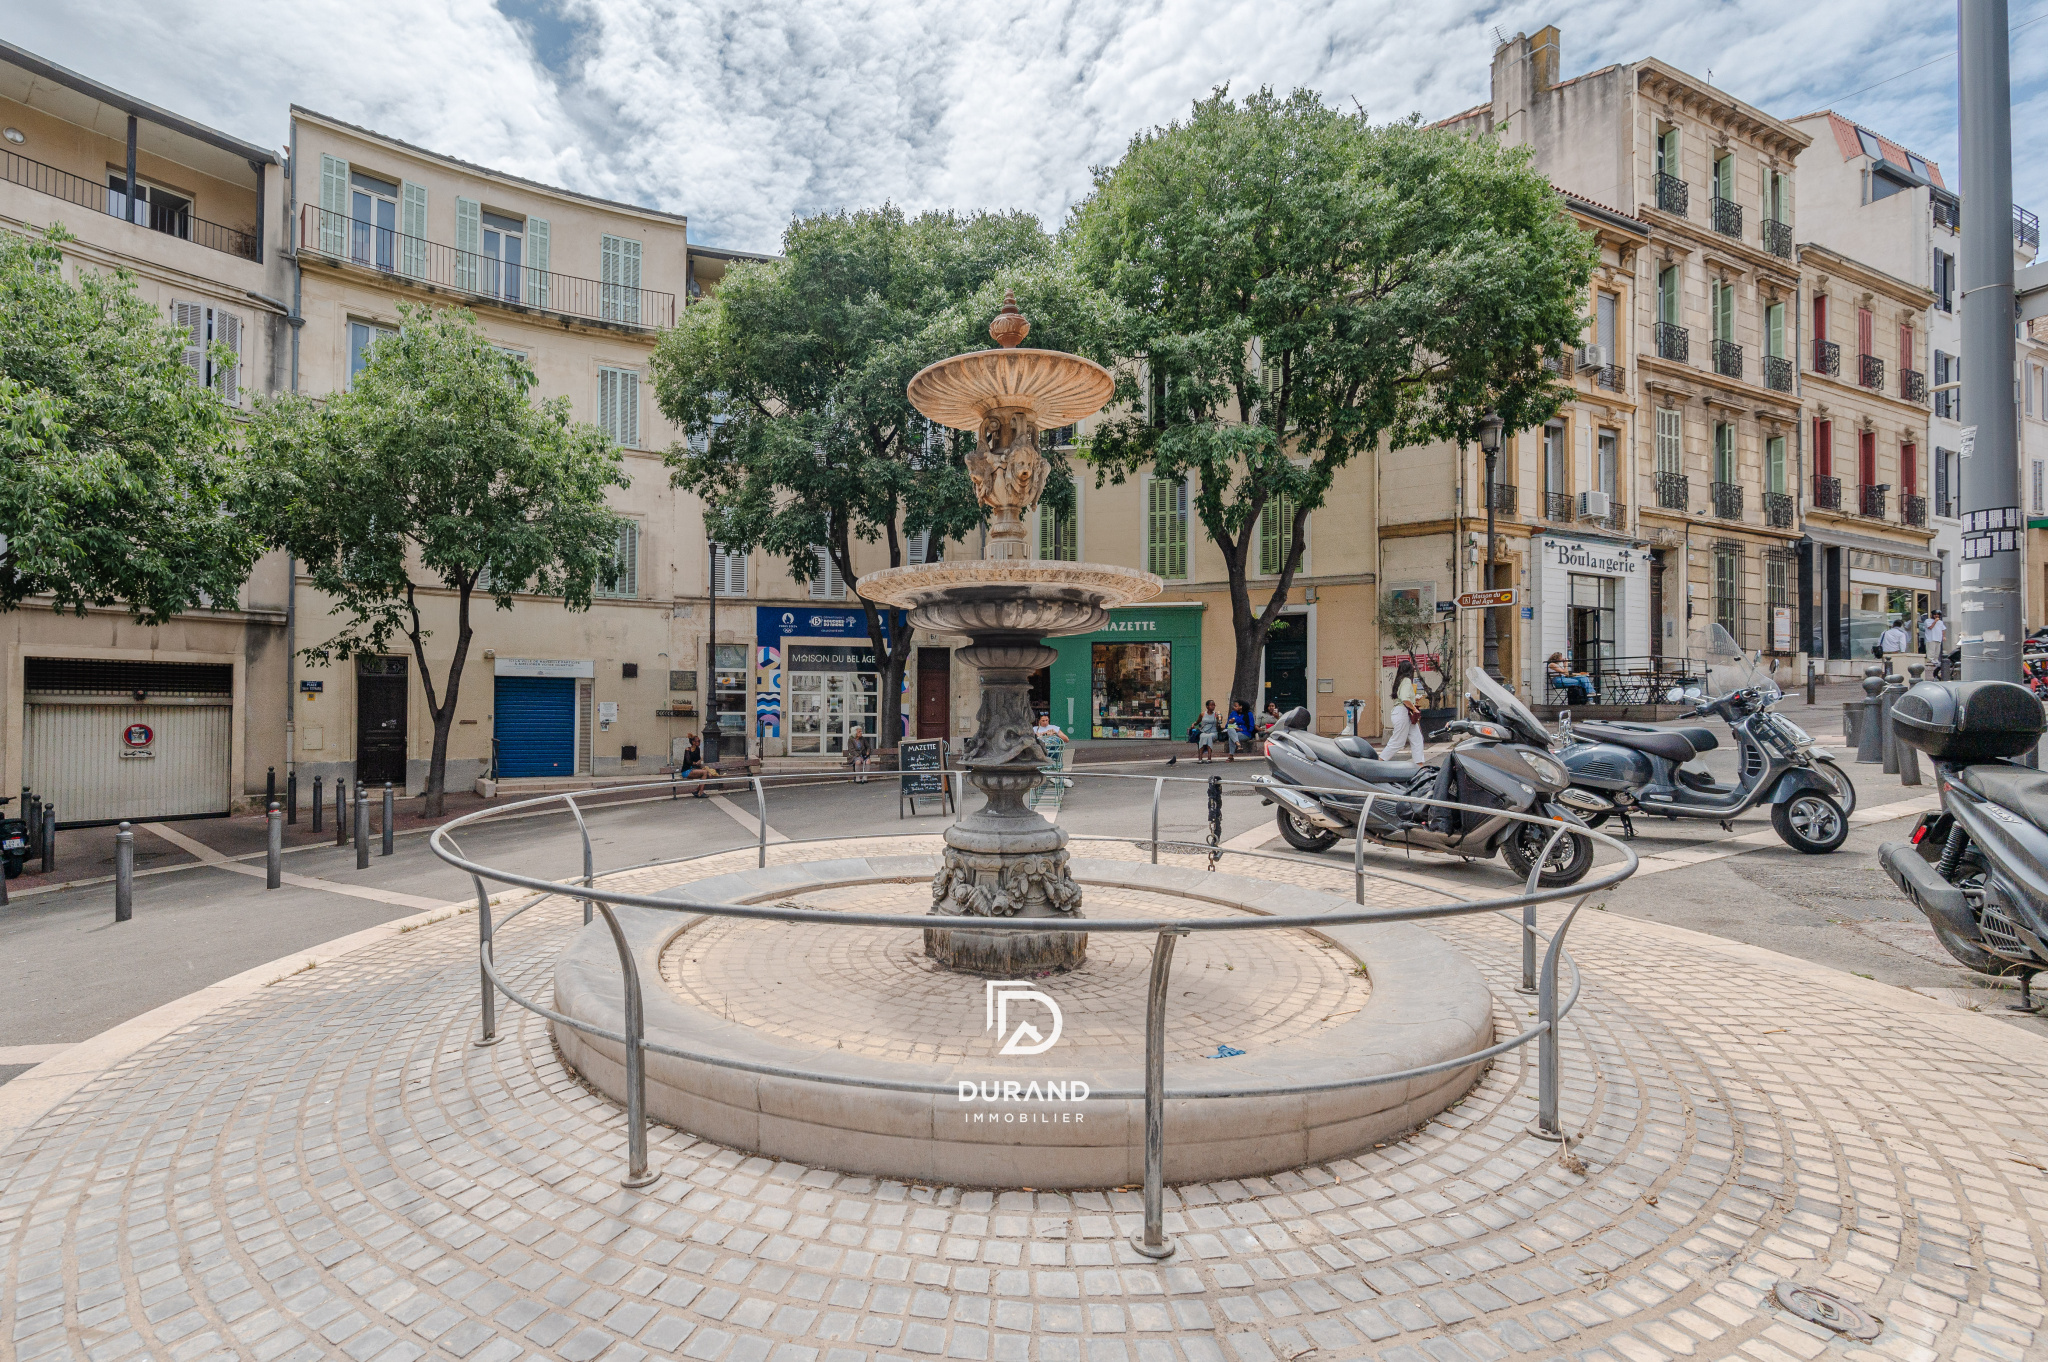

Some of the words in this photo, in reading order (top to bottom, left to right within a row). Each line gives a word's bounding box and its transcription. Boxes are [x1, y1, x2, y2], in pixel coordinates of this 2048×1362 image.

[1558, 545, 1635, 572] Boulangerie
[832, 654, 844, 663] DU
[846, 655, 860, 663] BEL
[908, 743, 937, 752] MAZETTE
